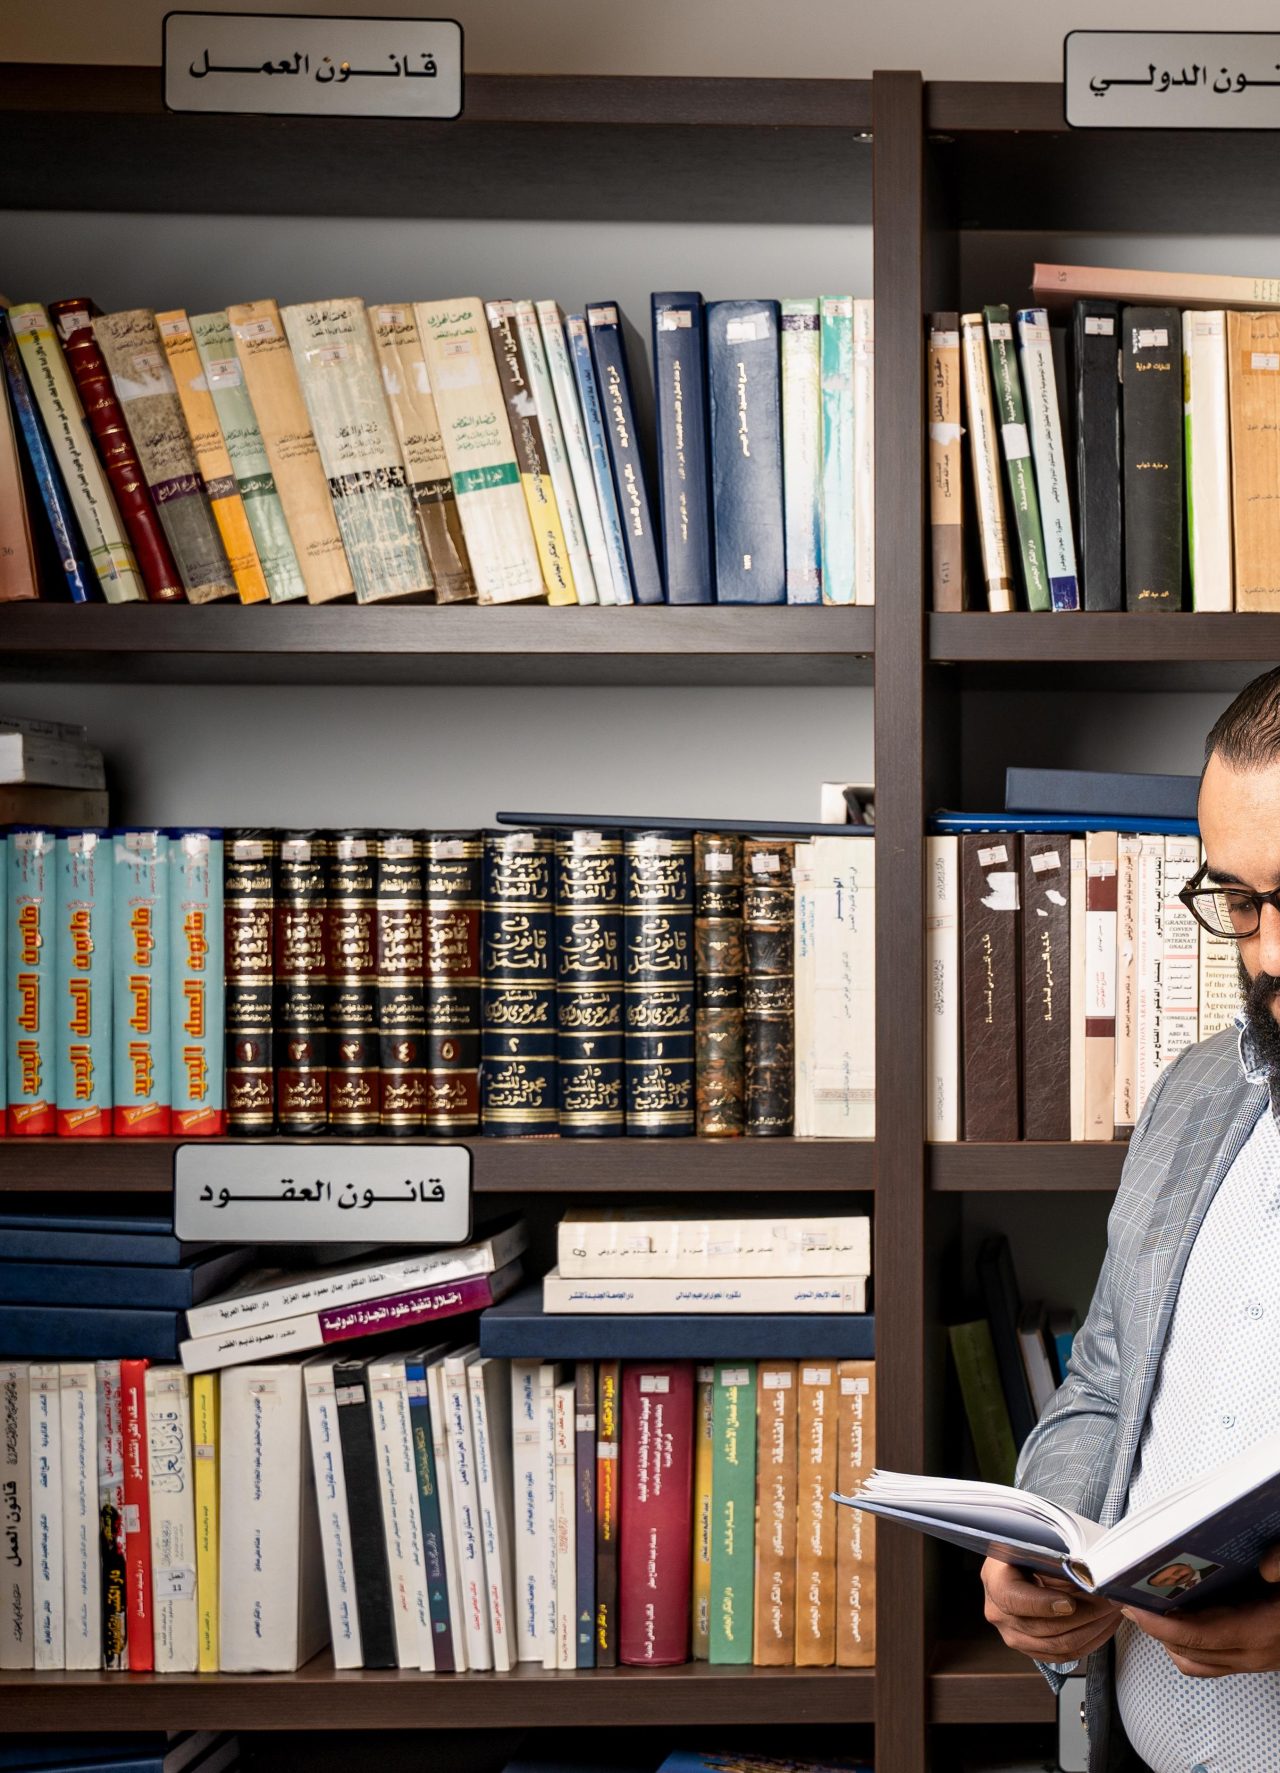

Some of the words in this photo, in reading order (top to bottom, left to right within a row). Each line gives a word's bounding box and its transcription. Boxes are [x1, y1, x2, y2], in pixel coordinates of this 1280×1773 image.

[189, 48, 310, 79] العمل
[314, 53, 438, 83] قانون
[200, 1178, 332, 1209] العقود
[337, 1179, 446, 1210] قانون
[3, 1480, 23, 1523] قانون
[3, 1525, 24, 1568] العمل
